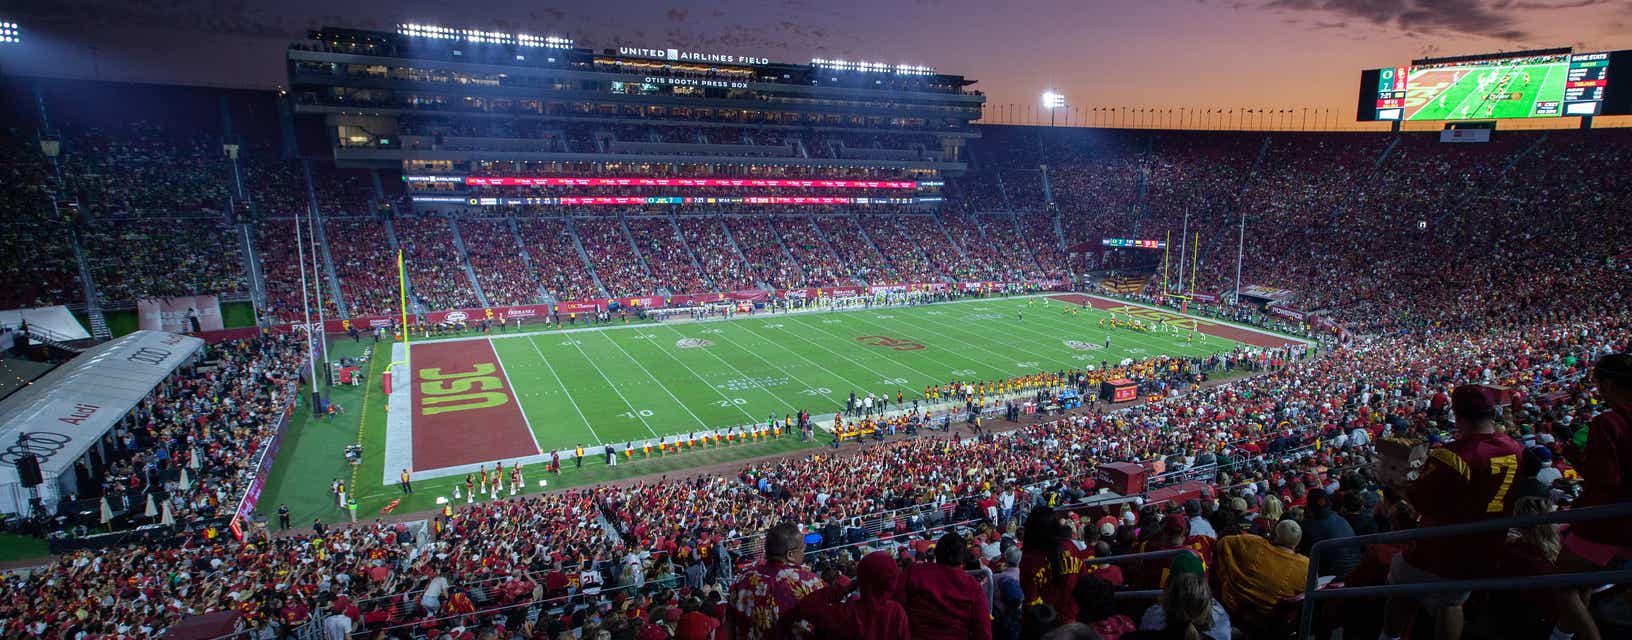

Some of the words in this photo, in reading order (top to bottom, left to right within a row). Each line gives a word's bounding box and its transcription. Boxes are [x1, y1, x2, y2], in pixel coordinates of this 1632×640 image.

[620, 47, 665, 57] UNITED
[680, 51, 734, 62] AIRLINES
[738, 56, 769, 65] FIELD
[645, 76, 665, 84] OTIS
[668, 78, 698, 86] BOOTH
[419, 363, 509, 416] USC
[717, 398, 748, 408] 20
[58, 403, 101, 426] Audi
[626, 409, 655, 419] 10
[1486, 454, 1519, 513] 7
[584, 575, 595, 584] 21
